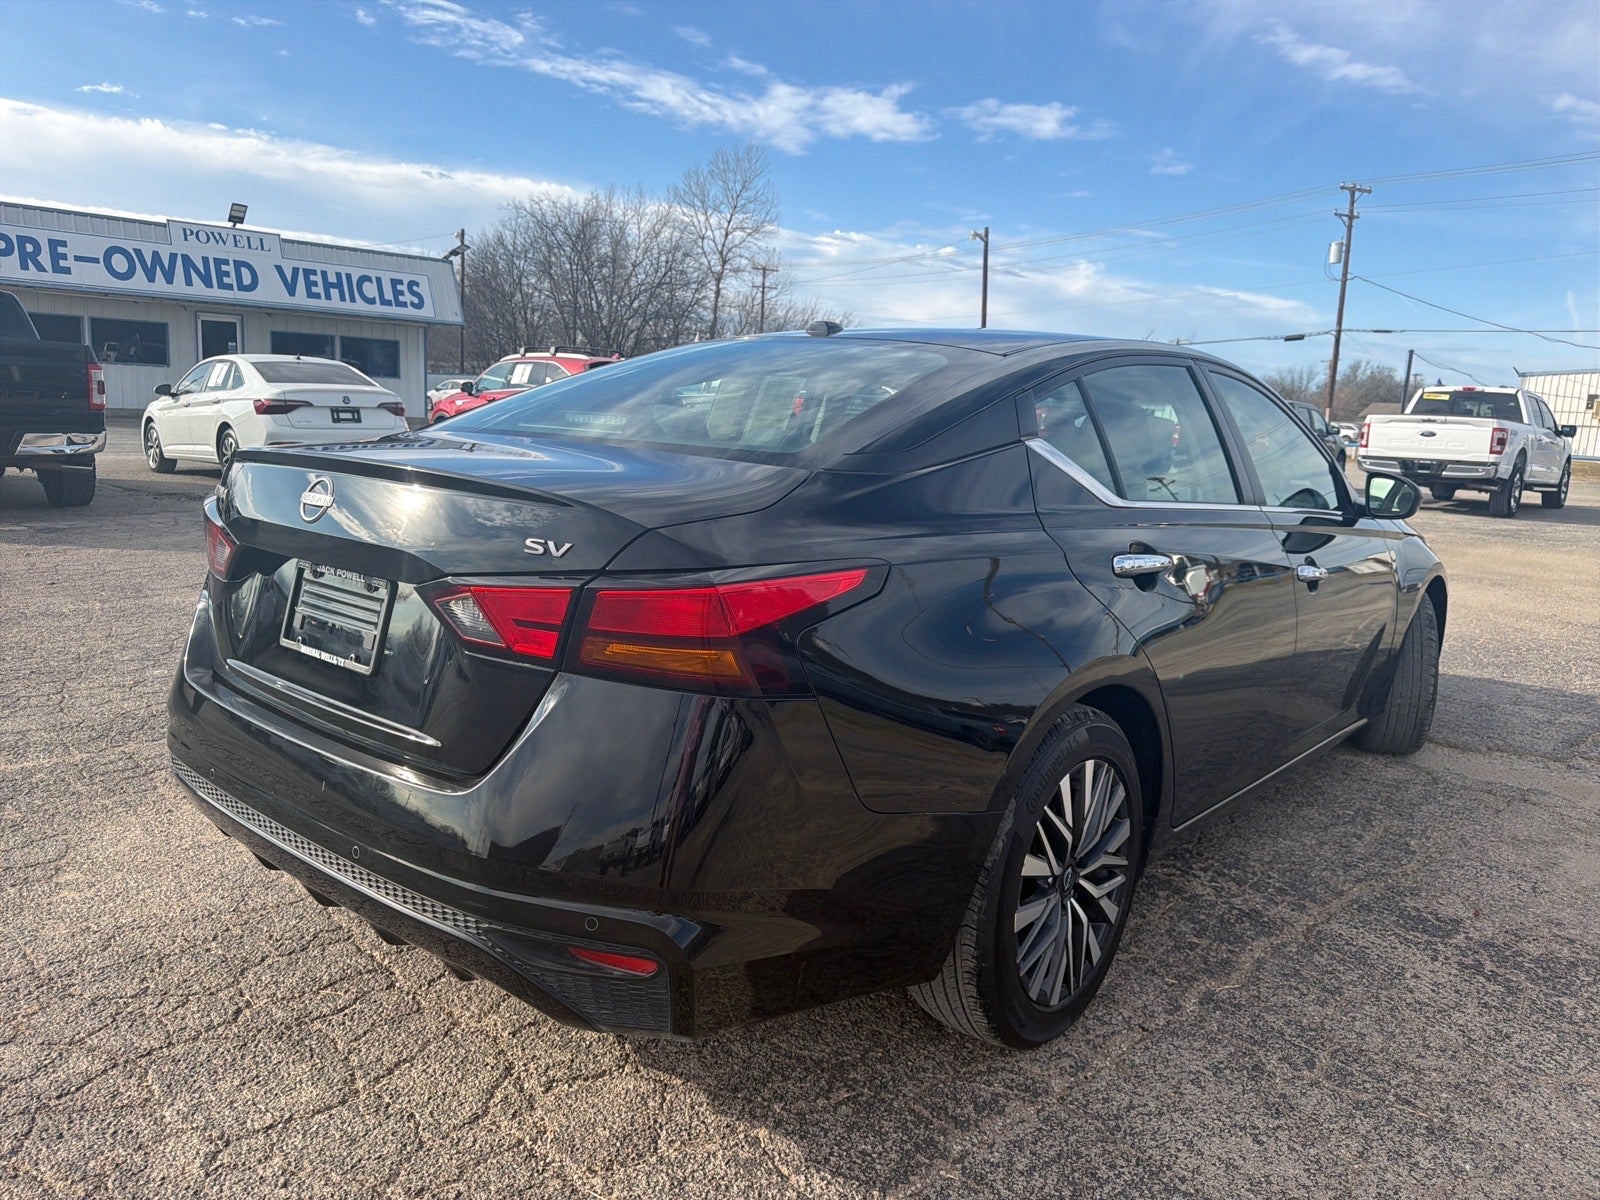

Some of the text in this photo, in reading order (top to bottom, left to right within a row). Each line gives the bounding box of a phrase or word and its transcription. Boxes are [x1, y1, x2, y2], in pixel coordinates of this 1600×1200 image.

[182, 227, 271, 252] POWELL
[274, 264, 425, 310] VEHICLES
[523, 538, 574, 558] SV
[317, 565, 336, 576] JACK
[336, 568, 366, 583] POWELL
